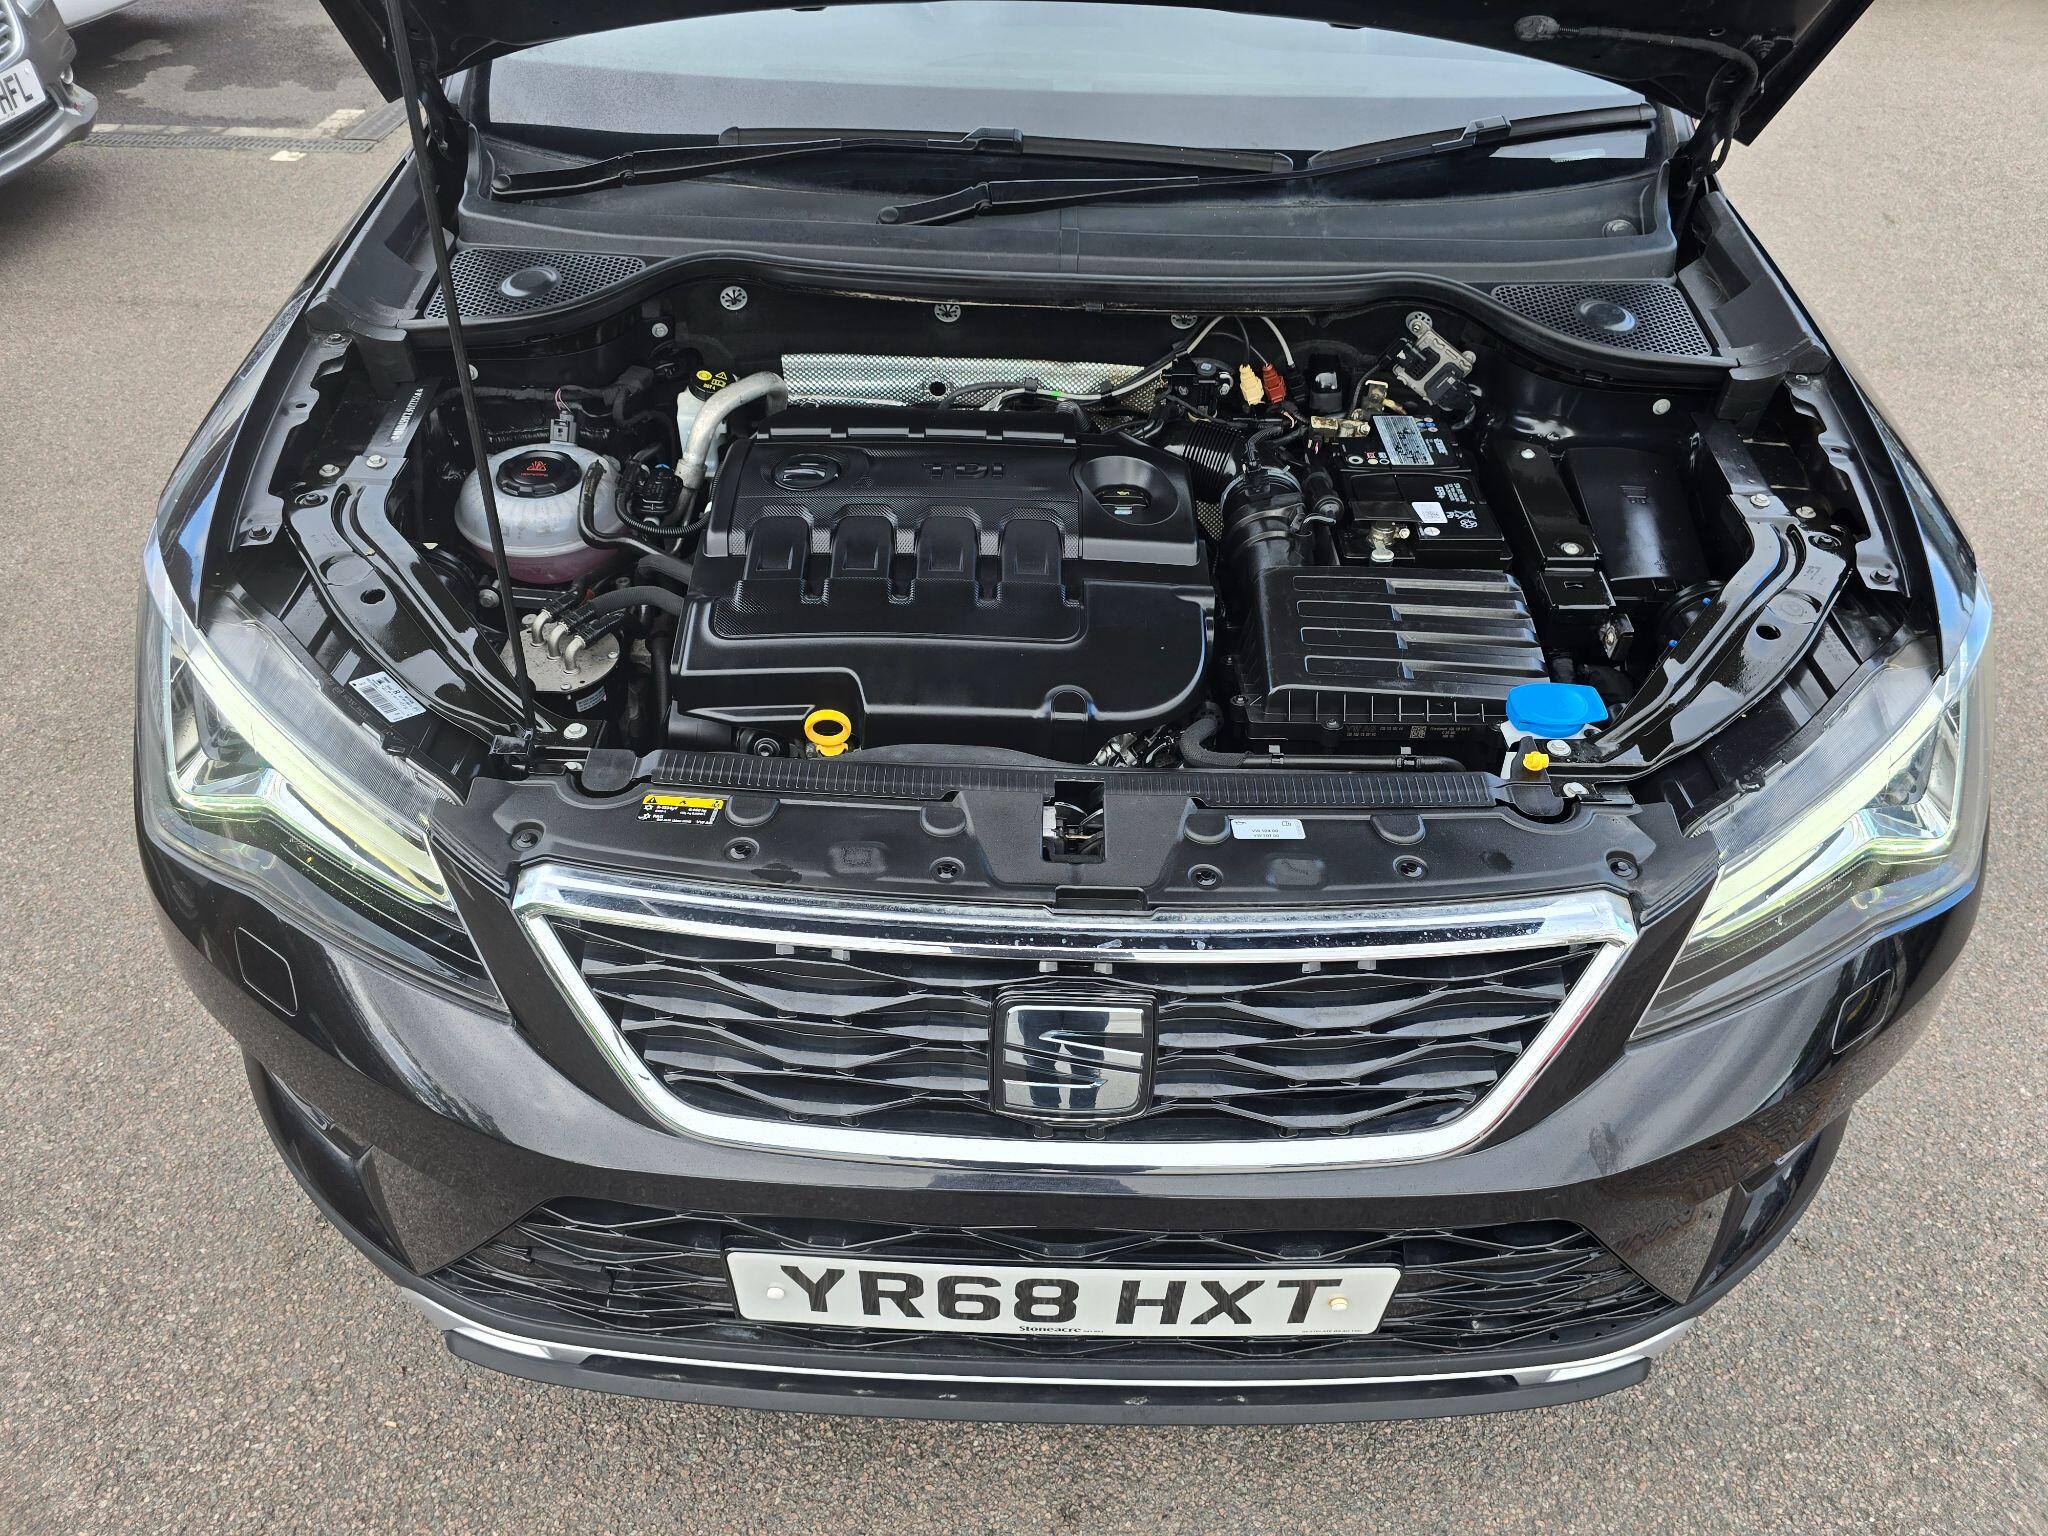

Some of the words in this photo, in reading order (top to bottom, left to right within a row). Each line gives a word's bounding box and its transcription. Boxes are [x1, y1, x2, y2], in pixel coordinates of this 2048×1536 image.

[923, 463, 1004, 480] TDI
[780, 1265, 1080, 1323] YR68
[1115, 1279, 1343, 1325] HXT
[1019, 1325, 1082, 1333] Stoneacre
